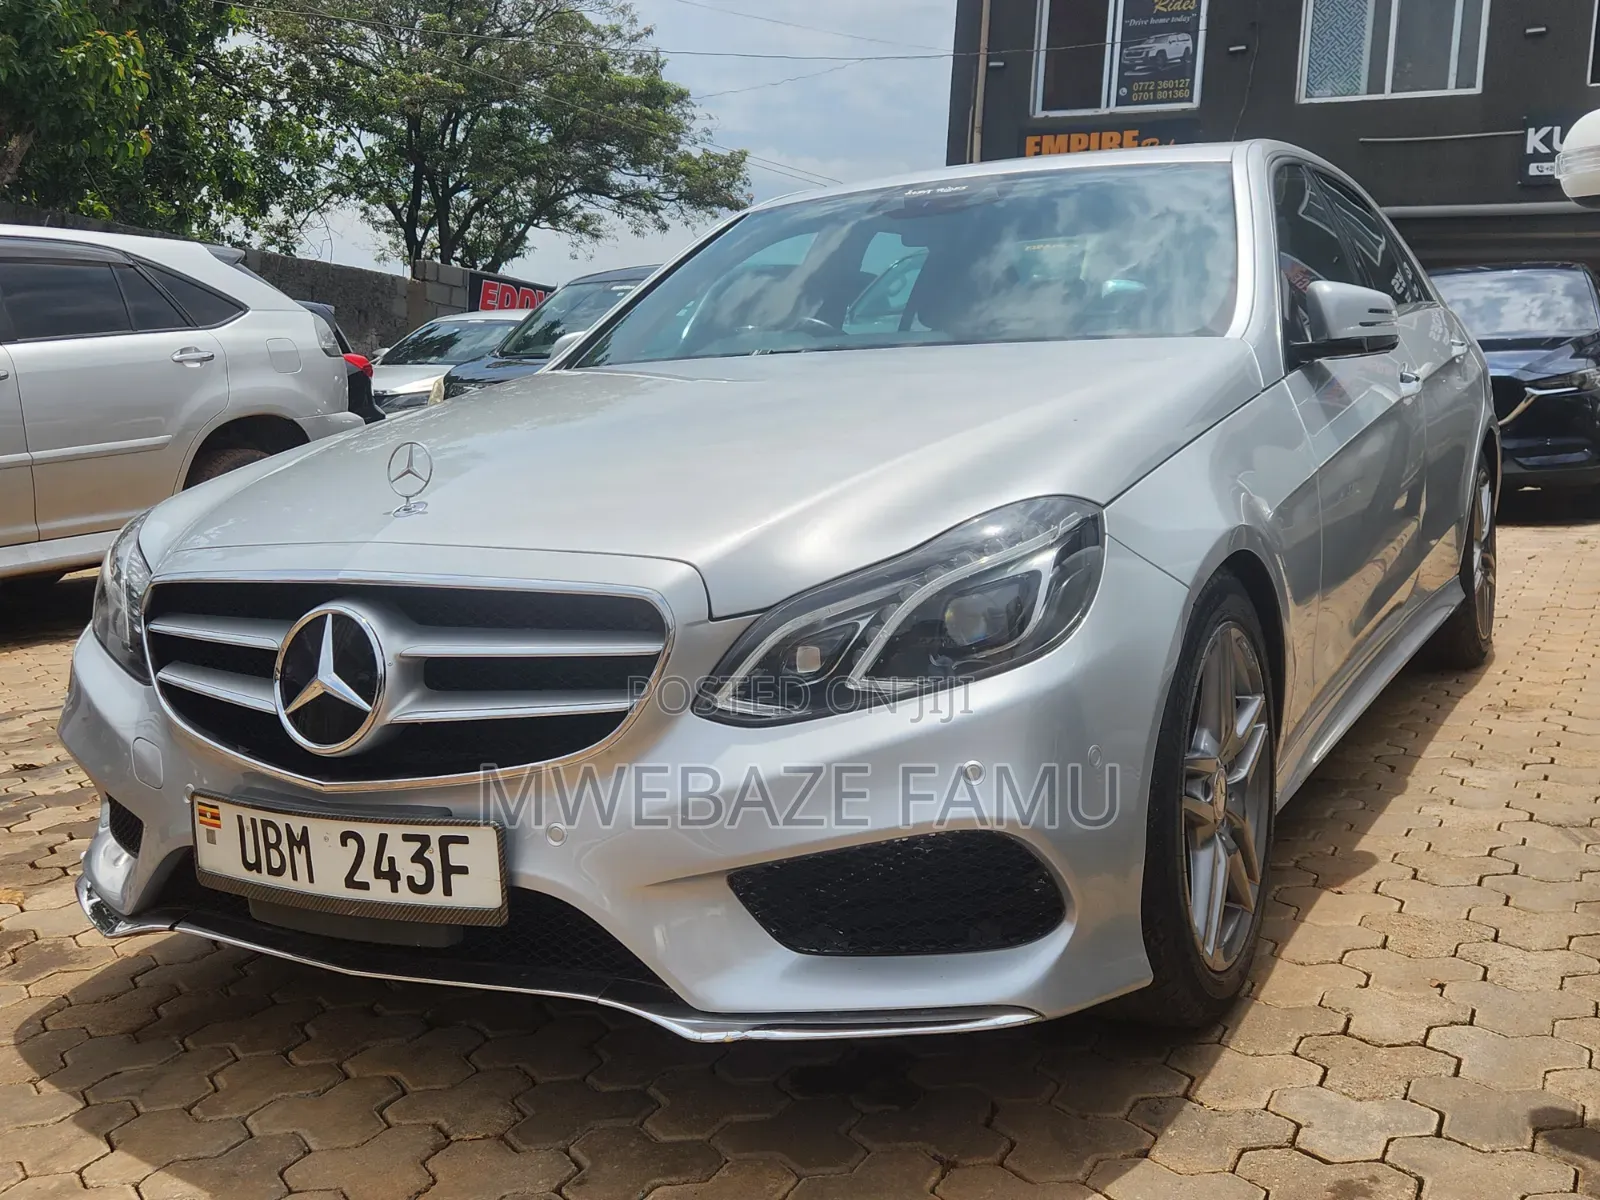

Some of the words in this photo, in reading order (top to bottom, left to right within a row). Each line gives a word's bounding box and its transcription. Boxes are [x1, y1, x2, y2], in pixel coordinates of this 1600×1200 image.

[1149, 17, 1169, 25] home
[1132, 81, 1155, 92] 0772
[1157, 78, 1191, 90] 360127
[1132, 91, 1154, 102] 0701
[1156, 89, 1190, 100] 801360
[1025, 129, 1139, 157] EMPIRE
[236, 814, 315, 884] UBM
[339, 829, 470, 897] 243F
